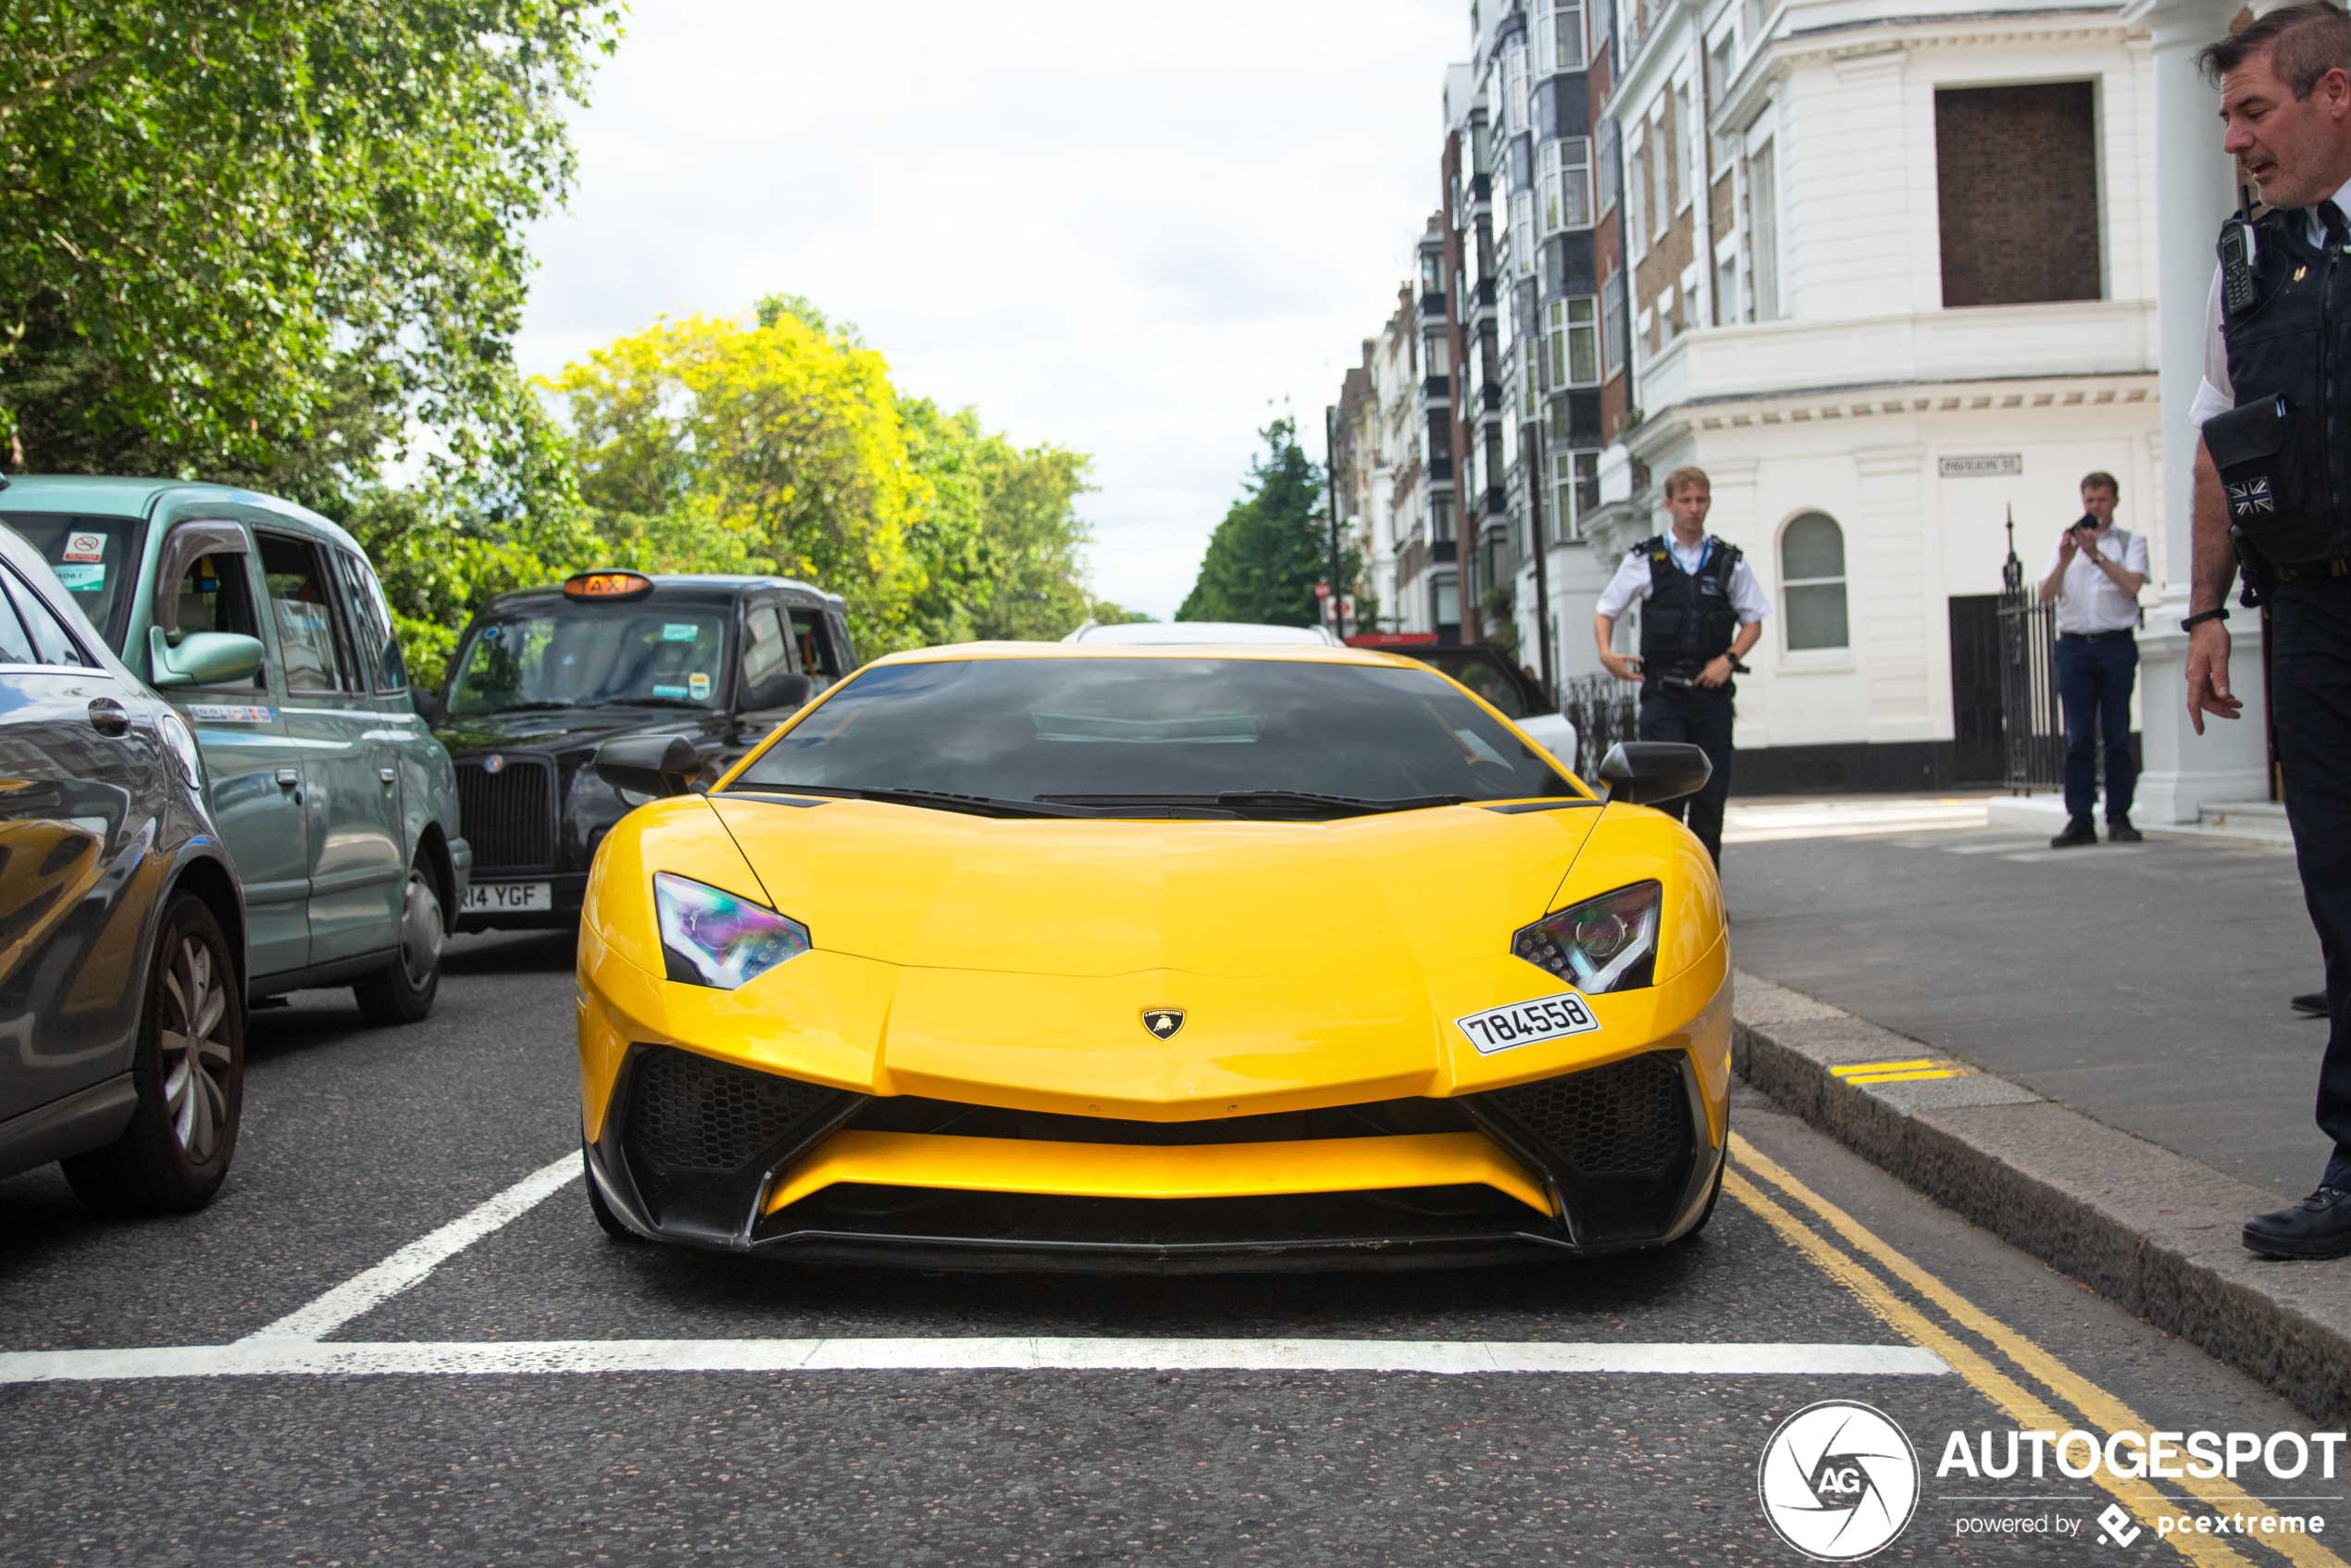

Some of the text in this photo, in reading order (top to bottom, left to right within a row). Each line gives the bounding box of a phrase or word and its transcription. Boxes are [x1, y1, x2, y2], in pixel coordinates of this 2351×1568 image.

[1944, 459, 1997, 471] PAVILION
[579, 579, 628, 594] TAXI
[494, 886, 535, 906] YGF
[1467, 999, 1588, 1045] 784558
